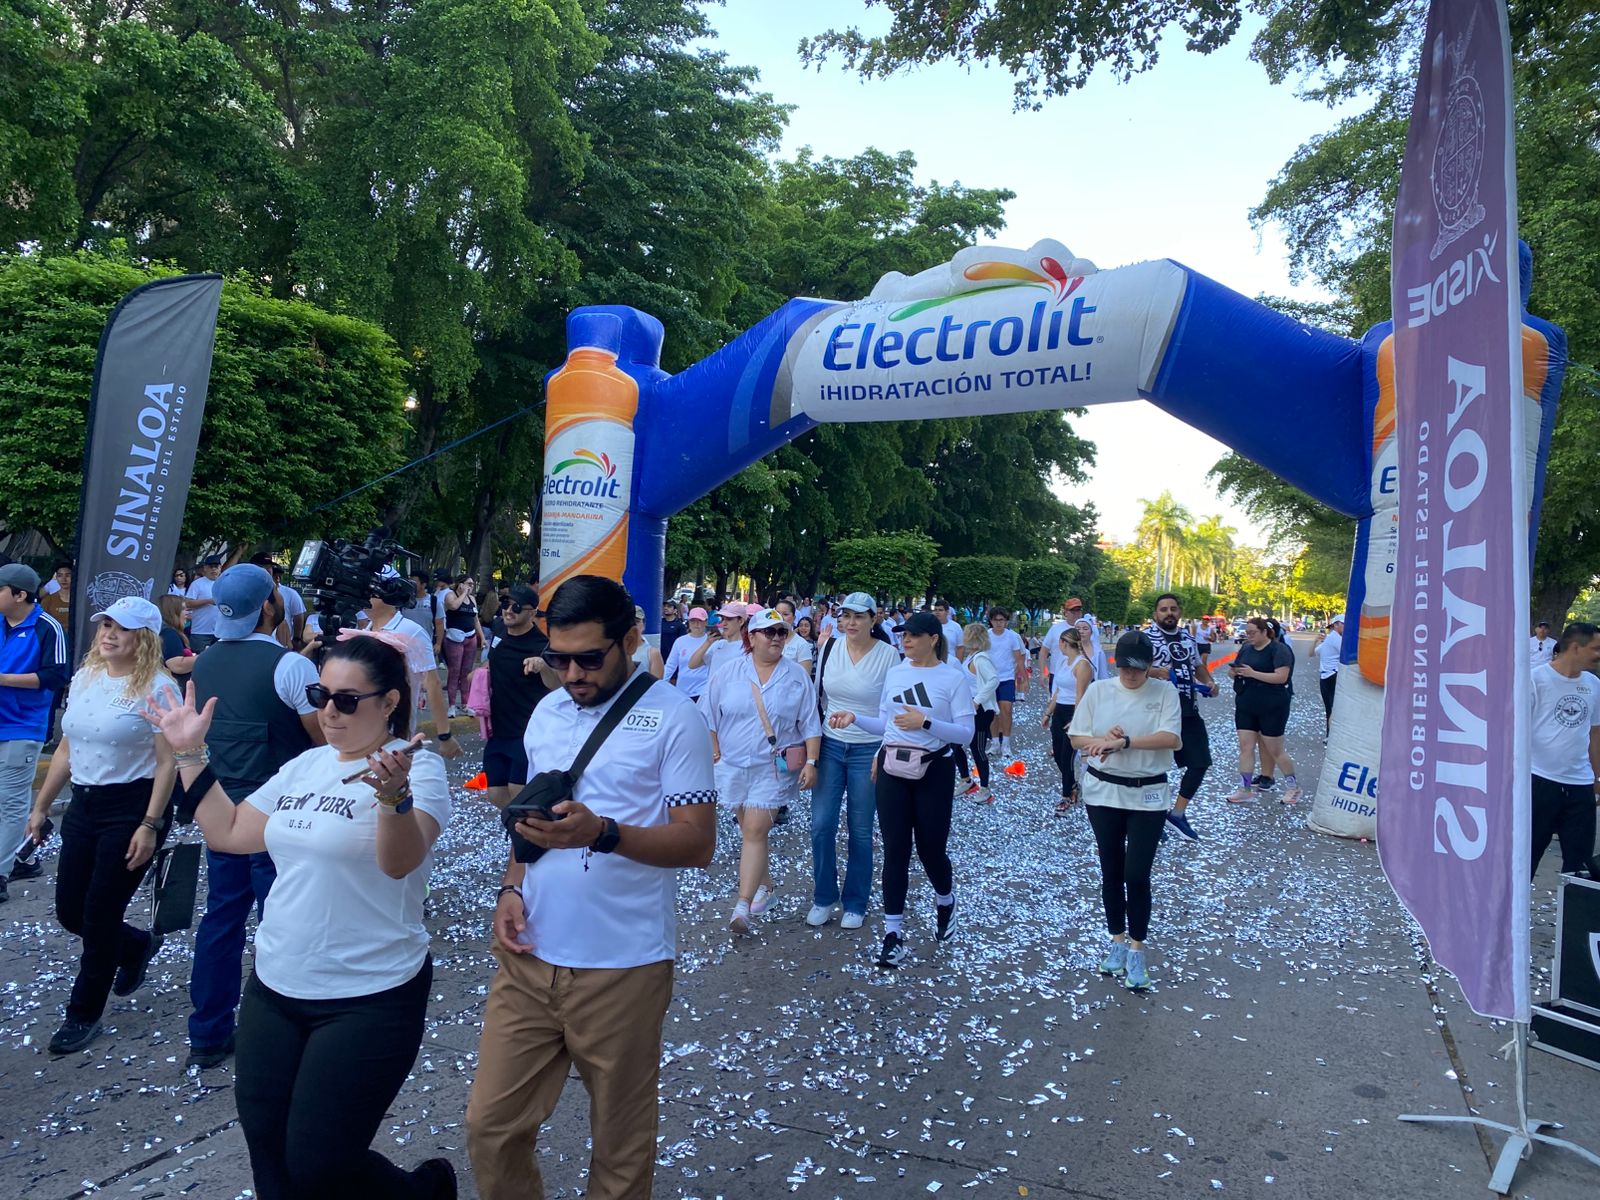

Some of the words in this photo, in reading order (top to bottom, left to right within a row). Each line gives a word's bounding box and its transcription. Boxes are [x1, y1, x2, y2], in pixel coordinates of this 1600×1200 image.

[822, 297, 1097, 371] Electrolit
[820, 371, 992, 401] ¡HIDRATACIÓN
[1000, 362, 1092, 389] TOTAL!
[106, 382, 175, 560] SINALOA
[142, 484, 166, 562] GOBIERNO
[160, 449, 173, 477] DEL
[168, 385, 187, 442] ESTADO
[627, 714, 659, 728] 0755
[273, 792, 315, 813] NEW
[313, 795, 357, 820] YORK
